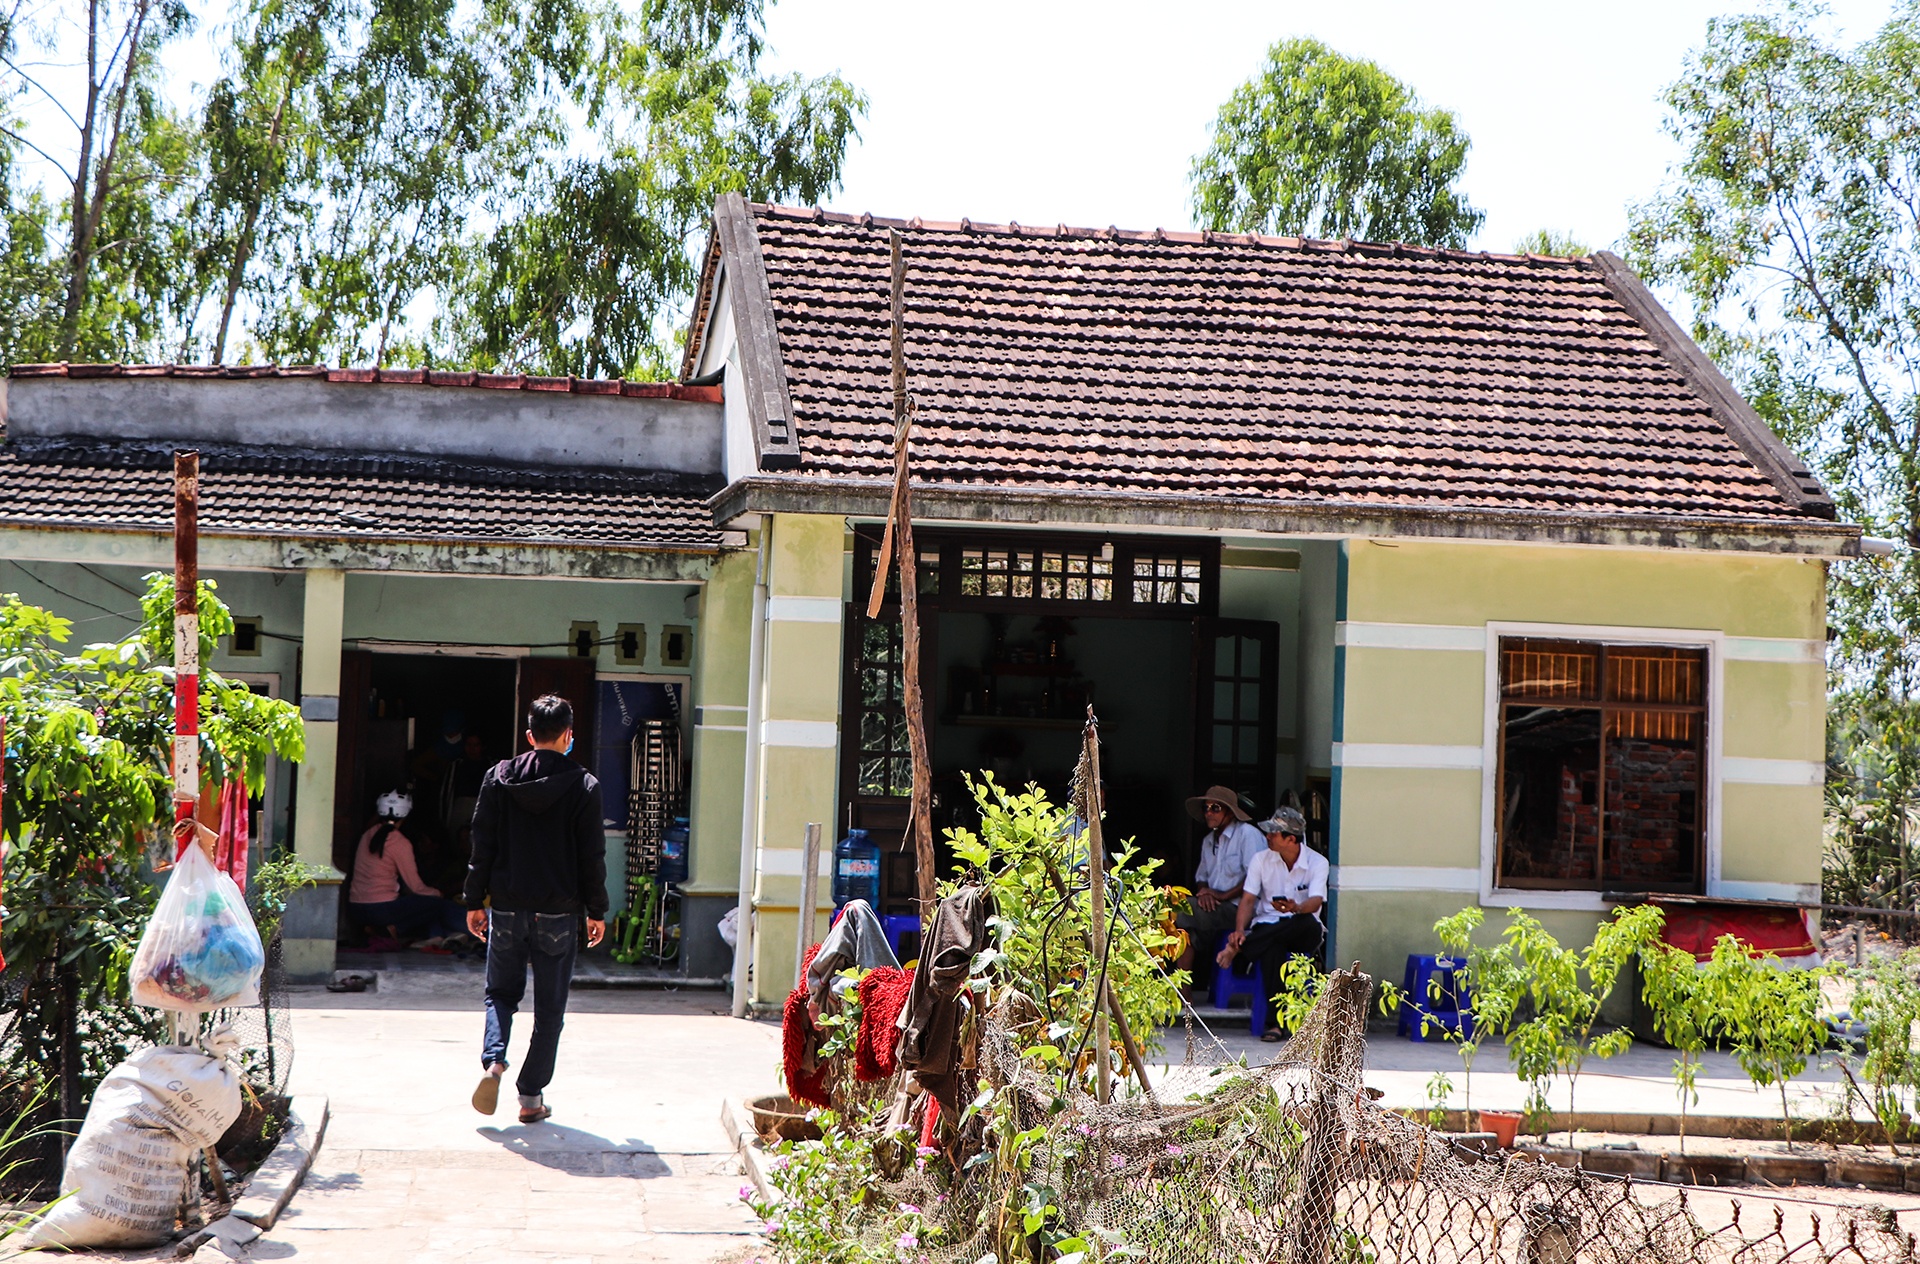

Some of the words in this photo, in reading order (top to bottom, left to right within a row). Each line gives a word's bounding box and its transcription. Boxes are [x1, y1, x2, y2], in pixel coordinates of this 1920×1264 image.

[96, 1142, 114, 1158] TOTAL
[98, 1160, 131, 1180] COUNTRY
[131, 1171, 141, 1183] OF
[105, 1194, 129, 1213] GROSS
[106, 1212, 118, 1223] AS
